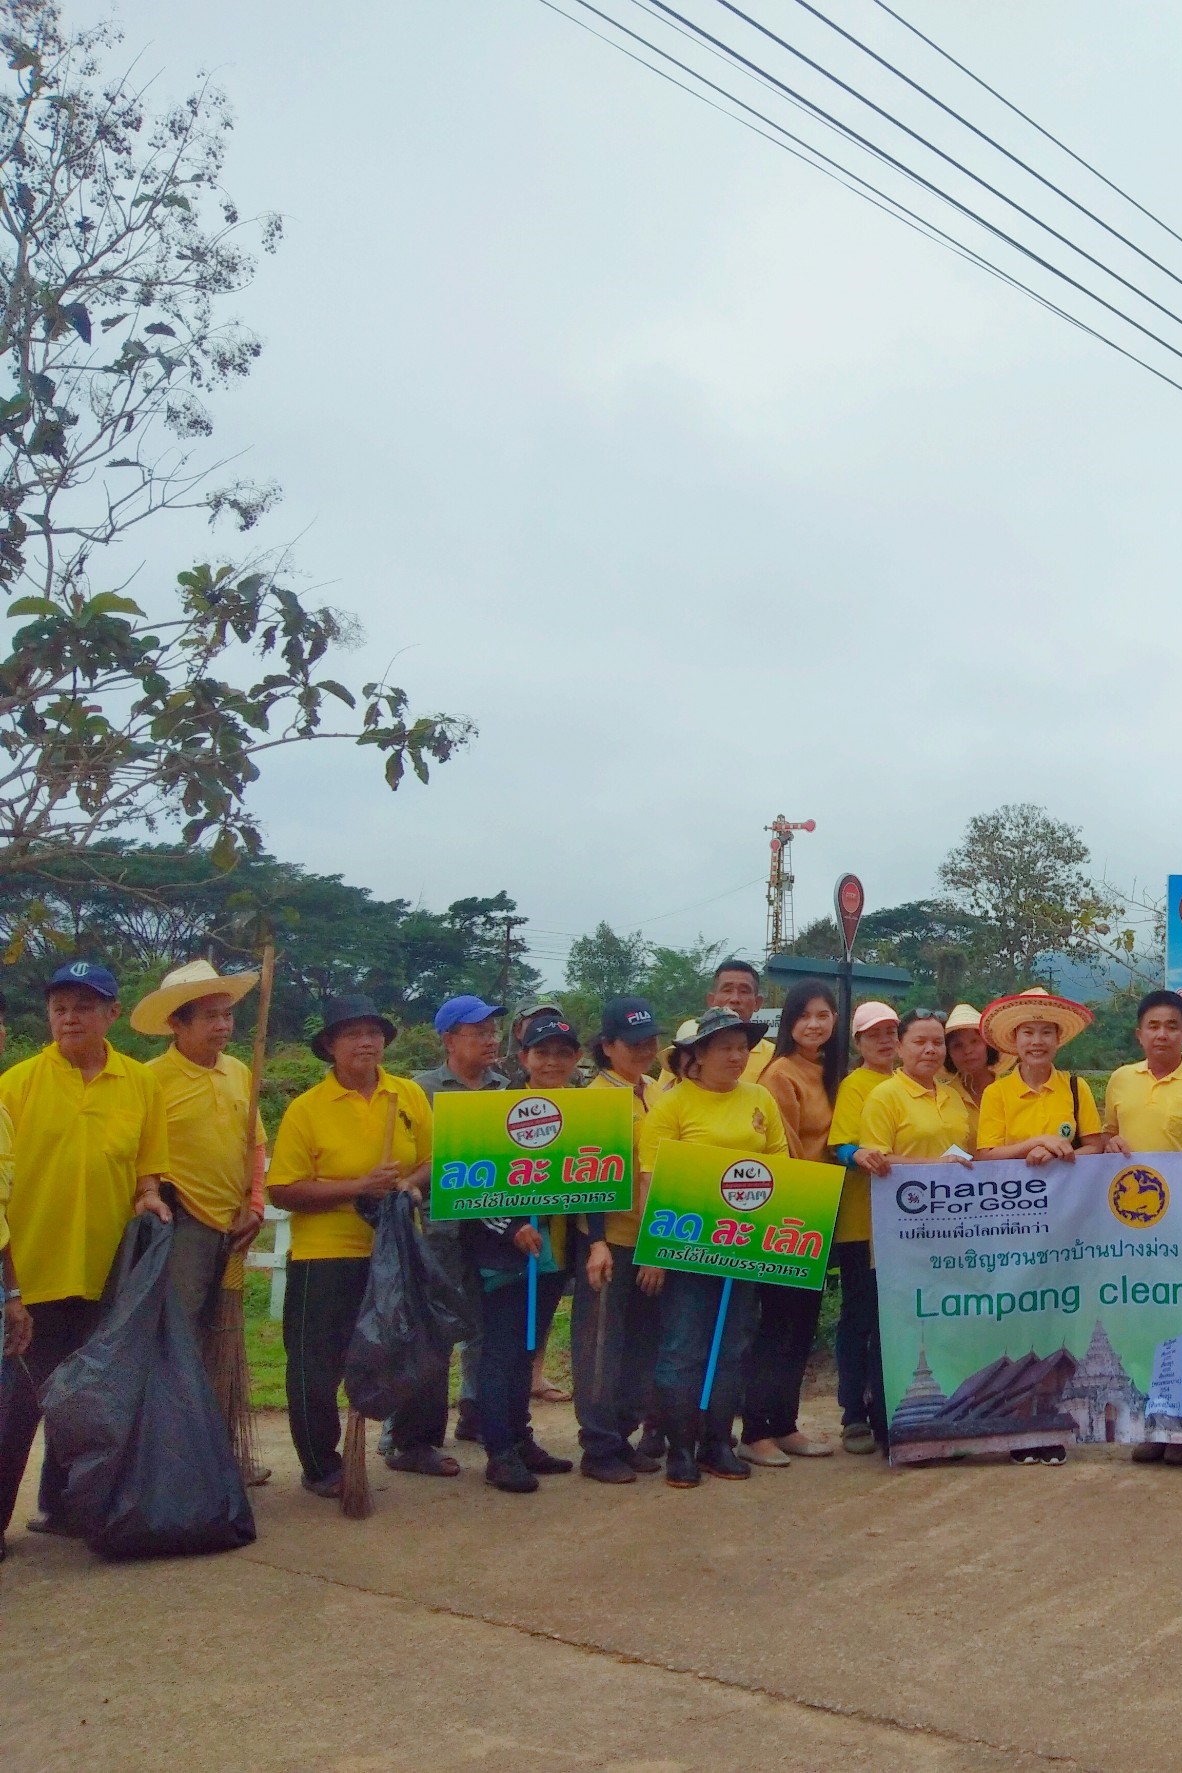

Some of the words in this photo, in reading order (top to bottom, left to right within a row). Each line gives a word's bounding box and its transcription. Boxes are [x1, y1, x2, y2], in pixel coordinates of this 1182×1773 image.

[626, 1010, 651, 1023] FILA
[441, 1160, 496, 1189] ลด
[508, 1158, 551, 1186] ละ
[562, 1146, 625, 1183] เลิก
[454, 1191, 616, 1209] การใช้โฟมบรรจุอาหาร
[896, 1179, 1047, 1214] Change
[930, 1200, 974, 1214] For
[980, 1195, 1048, 1211] Good
[649, 1209, 703, 1242] ลด
[711, 1218, 754, 1246] ละ
[762, 1217, 823, 1259] เลิก
[899, 1219, 1049, 1239] เปลี่ยนเพื่อโลกที่ดีกว่า
[657, 1245, 808, 1278] การใช้โฟมบรรจุอาหาร
[930, 1239, 1179, 1272] ขอเชิญชวนชาวบ้านปางม่วง
[915, 1283, 1081, 1321] Lampang
